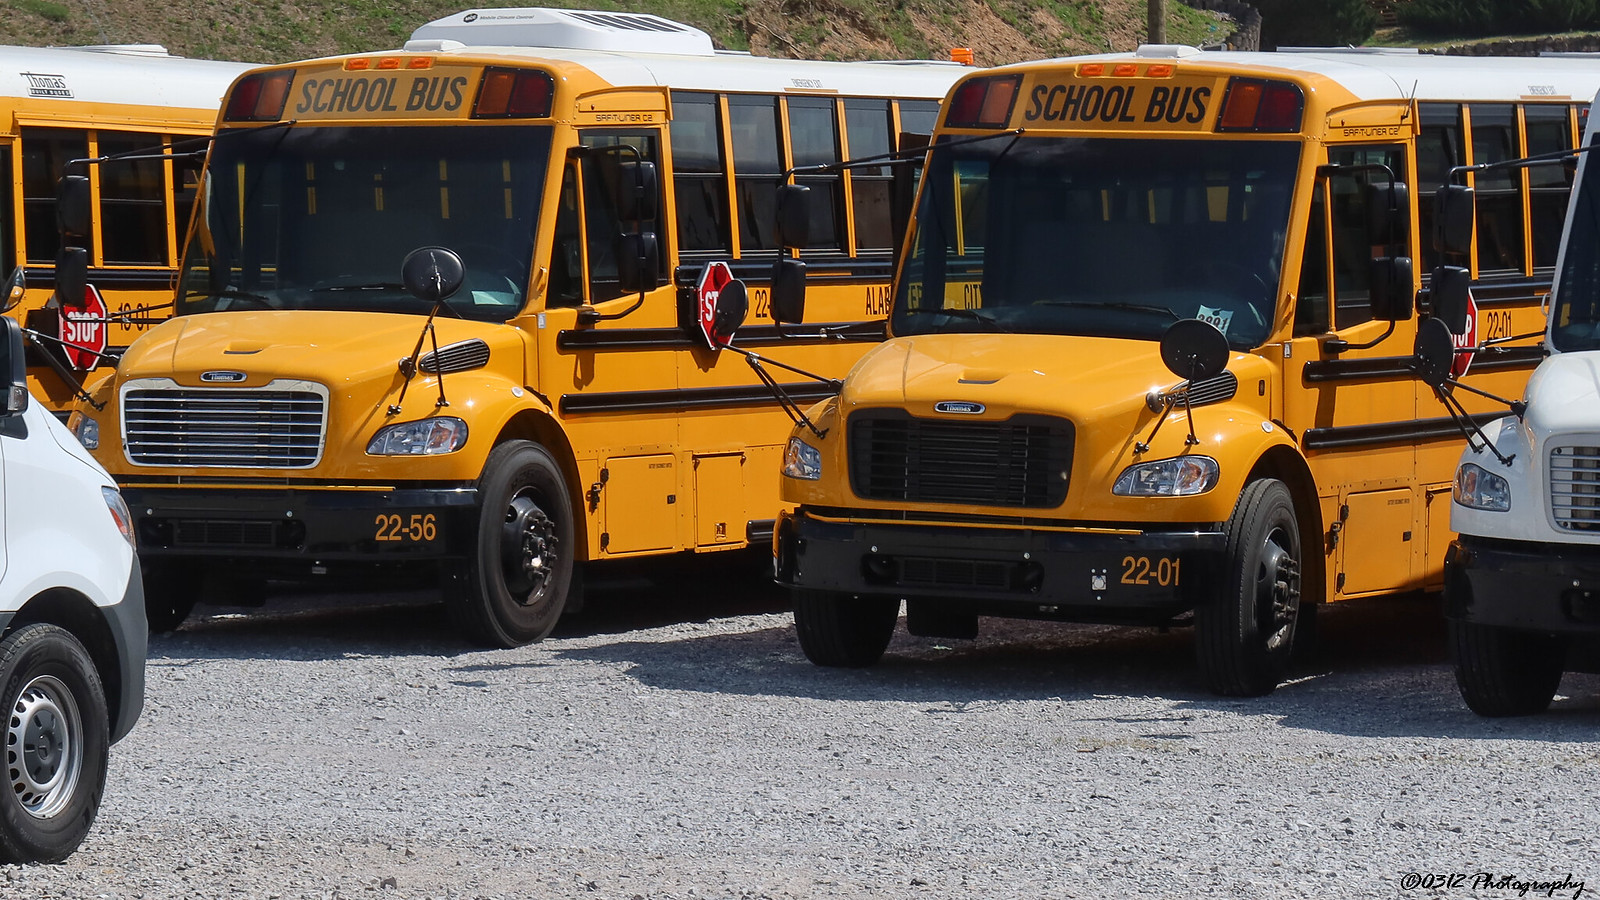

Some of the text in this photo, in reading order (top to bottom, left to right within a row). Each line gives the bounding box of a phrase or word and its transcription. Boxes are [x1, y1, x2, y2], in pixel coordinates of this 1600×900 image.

[19, 71, 66, 88] Thomas
[296, 76, 468, 113] SCHOOL BUS
[1025, 84, 1211, 123] SCHOOL BUS
[118, 302, 150, 331] 1901
[705, 291, 719, 322] ST
[67, 312, 99, 342] STOP
[1487, 311, 1512, 340] 22-01
[375, 514, 436, 541] 22-56
[1121, 556, 1180, 586] 22-01
